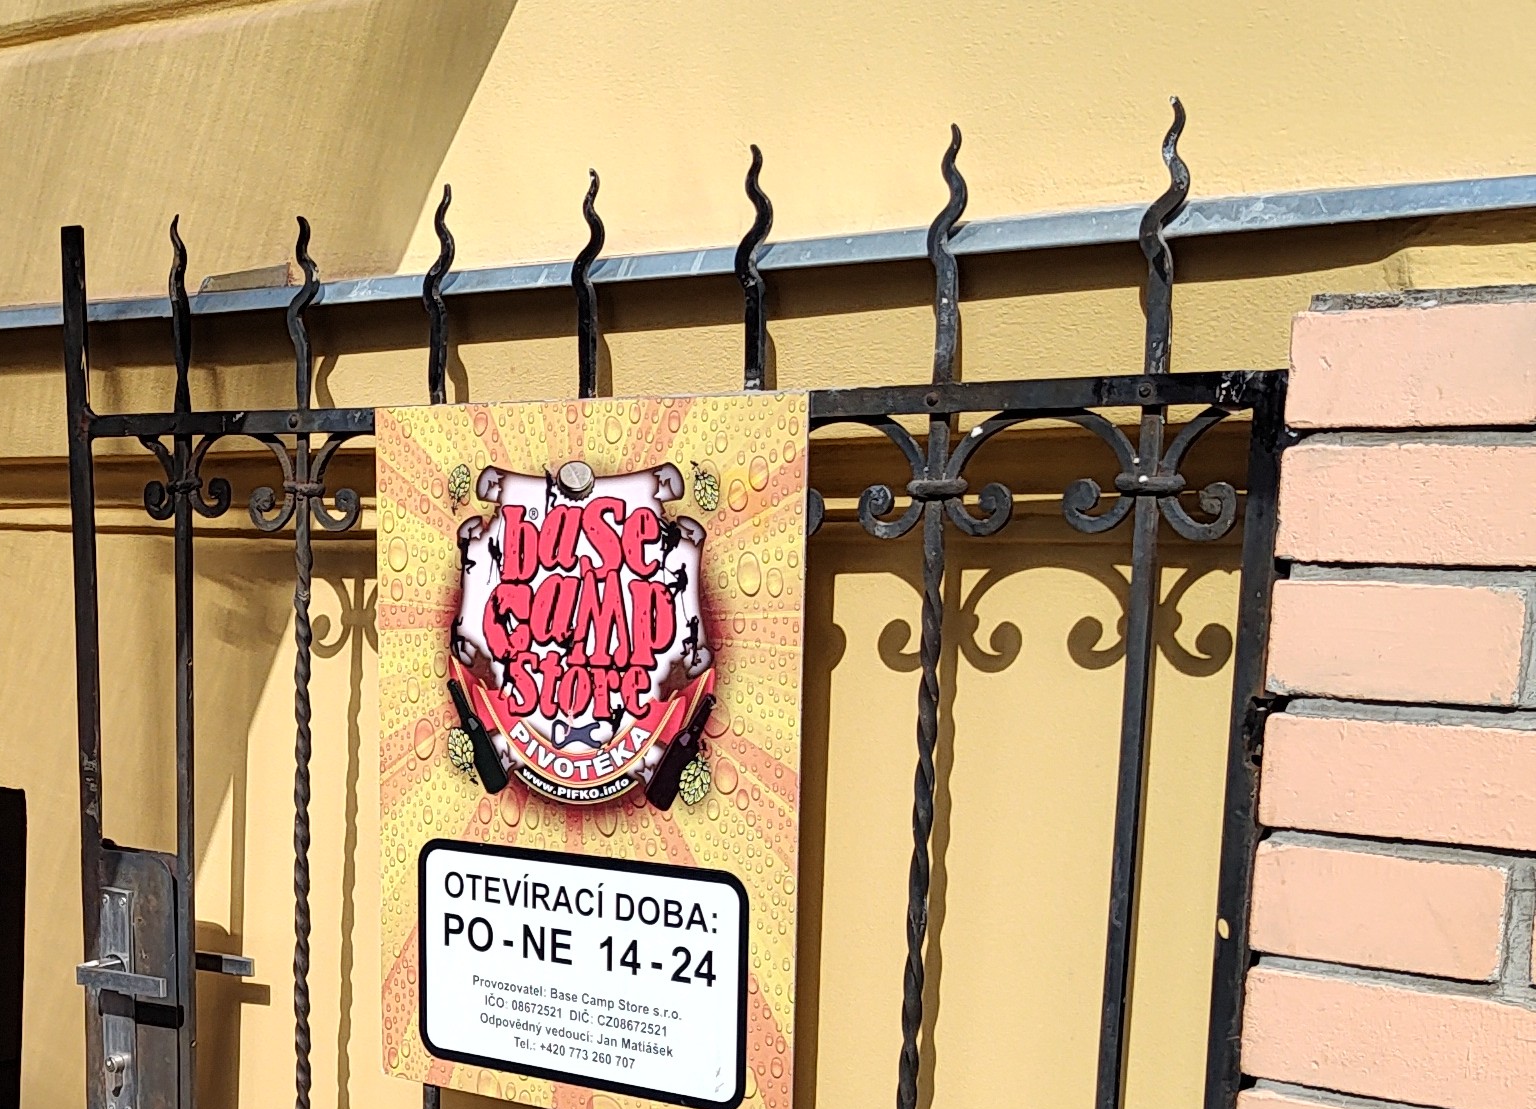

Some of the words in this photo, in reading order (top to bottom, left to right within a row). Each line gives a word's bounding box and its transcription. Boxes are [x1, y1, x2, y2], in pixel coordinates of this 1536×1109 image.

[509, 722, 652, 780] PIVOTÉKA
[522, 768, 630, 800] www.PIFKO.info
[444, 871, 604, 918] OTEVÍRACÍ
[615, 893, 718, 935] DOBA:
[472, 974, 547, 998] Provozovatel:
[550, 987, 578, 1003] Base
[581, 992, 615, 1011] Camp
[617, 998, 650, 1015] Store
[652, 1007, 682, 1021] s.r.o.
[484, 992, 508, 1009] IČO:
[511, 999, 562, 1019] 08672521
[569, 1008, 594, 1025] DIČ:
[597, 1014, 667, 1037] CZ08672521
[479, 1012, 543, 1037] Odpovědný
[544, 1026, 594, 1044] vedoucí:
[596, 1033, 618, 1048] Jan
[621, 1037, 674, 1058] Matiášek
[539, 1042, 566, 1057] +420
[568, 1046, 589, 1061] 773
[591, 1050, 612, 1065] 260
[614, 1055, 636, 1069] 707
